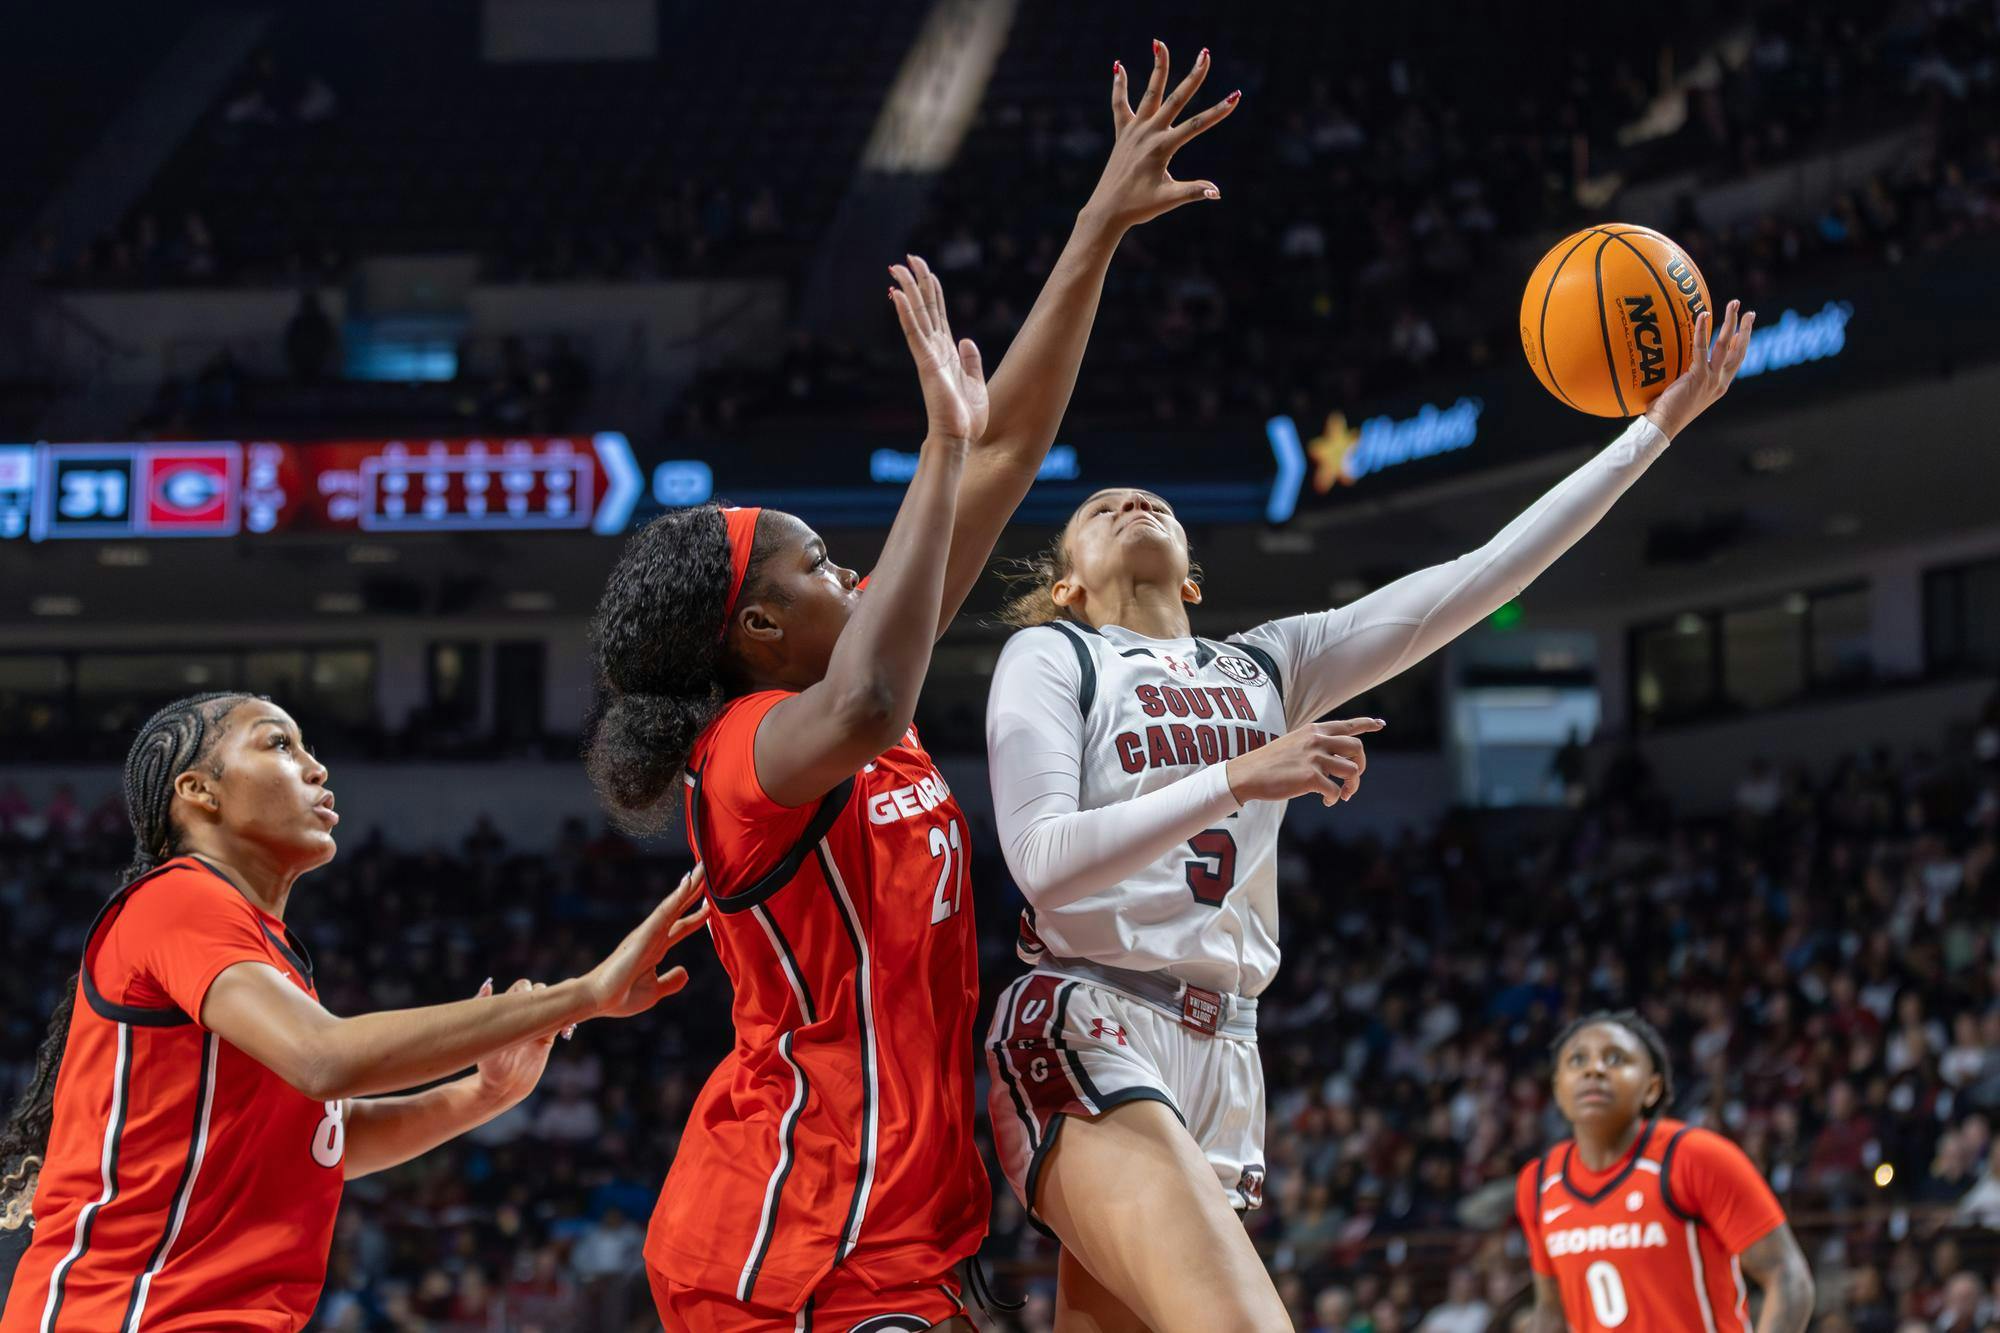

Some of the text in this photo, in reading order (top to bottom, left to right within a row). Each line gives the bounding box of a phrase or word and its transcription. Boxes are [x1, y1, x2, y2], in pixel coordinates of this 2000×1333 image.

[1615, 298, 1639, 390] OFFICIAL GAME BALL
[1624, 294, 1666, 388] NCAA
[60, 469, 128, 518] 31
[1219, 657, 1257, 679] SEC
[1134, 684, 1258, 722] SOUTH
[1115, 724, 1281, 775] CAROLIN
[928, 819, 963, 926] 21
[1185, 811, 1239, 908] 5
[310, 1098, 345, 1168] 8
[1545, 1220, 1668, 1258] GEORGIA
[1585, 1260, 1629, 1328] 0
